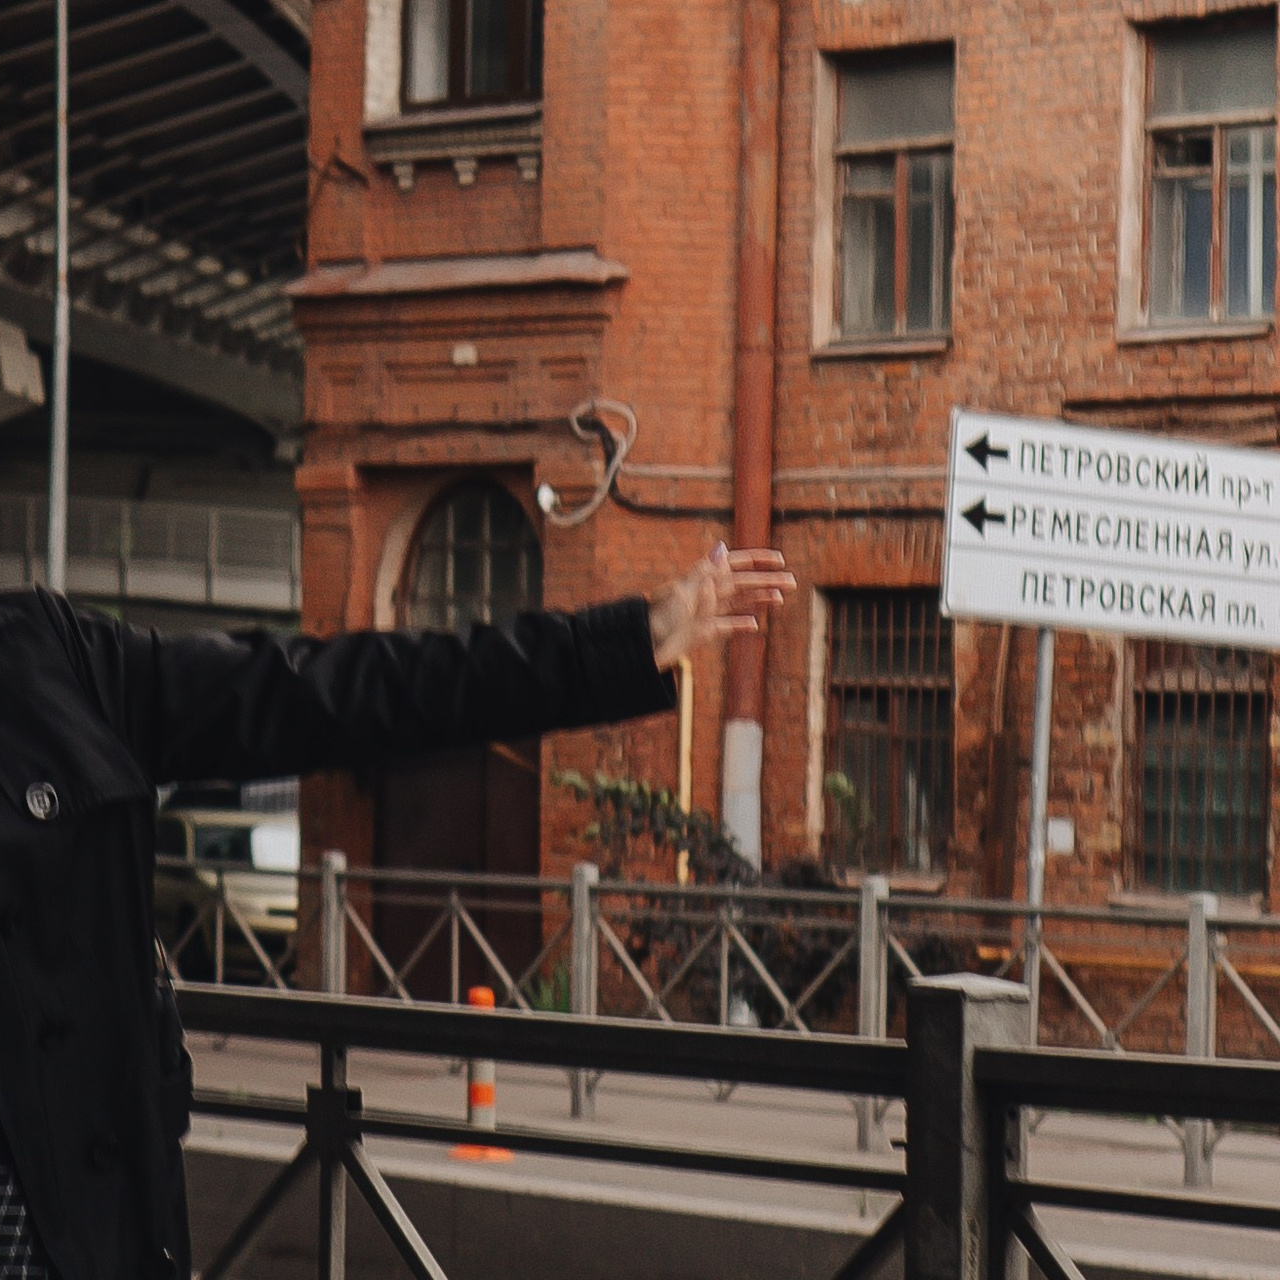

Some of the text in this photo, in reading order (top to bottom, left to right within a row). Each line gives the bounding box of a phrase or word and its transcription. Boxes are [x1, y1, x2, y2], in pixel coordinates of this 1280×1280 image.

[1020, 439, 1274, 510] ПЕТРОВСКИЙ пр-т
[1011, 504, 1279, 573] РЕМЕСЛЕННАЯ ул.
[1021, 570, 1265, 631] ПЕТРОВСКАЯ пл.
